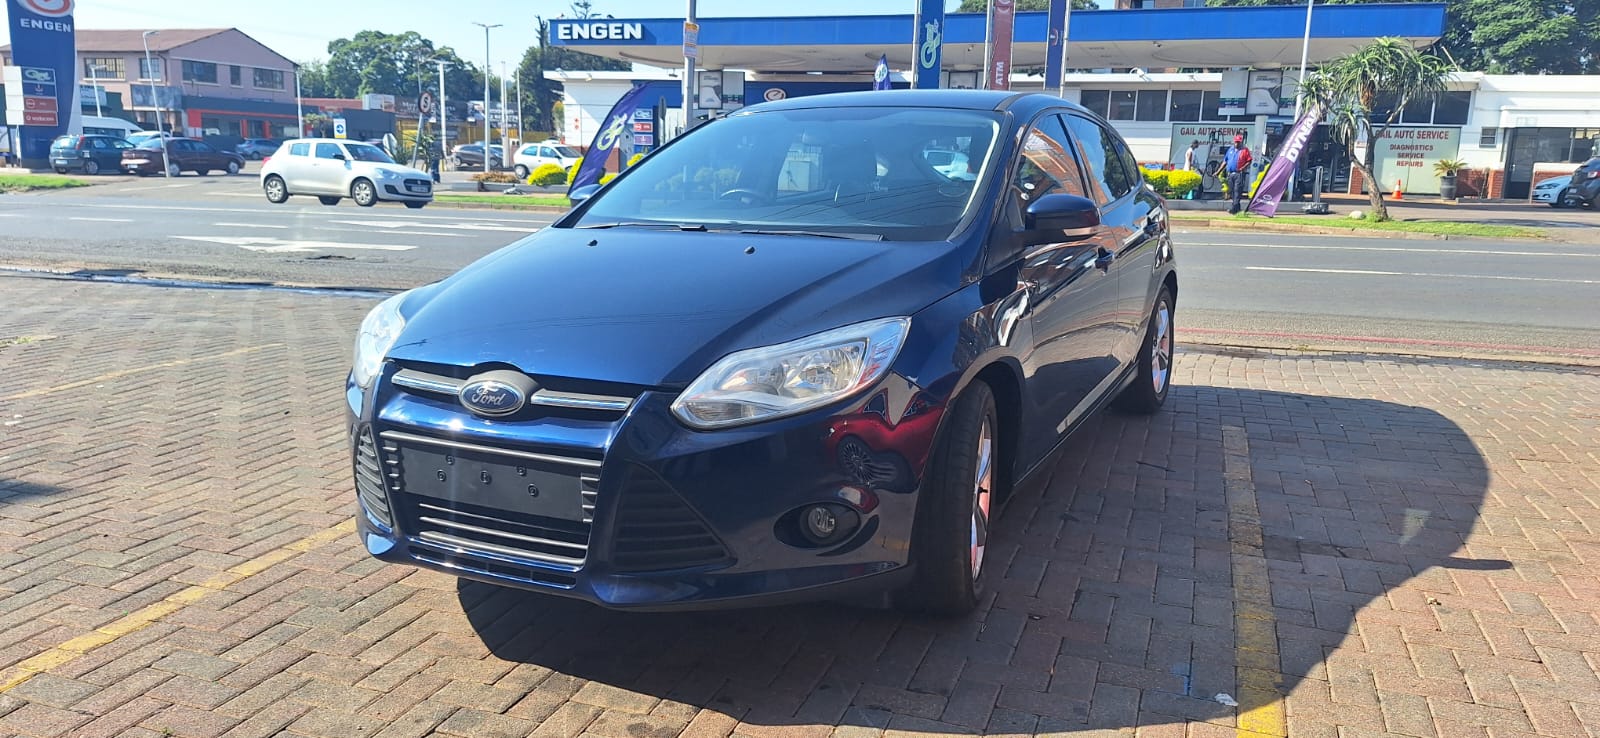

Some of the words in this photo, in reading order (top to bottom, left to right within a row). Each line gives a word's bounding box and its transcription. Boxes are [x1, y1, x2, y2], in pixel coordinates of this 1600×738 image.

[20, 18, 71, 32] ENGEN
[557, 23, 642, 40] ENGEN
[995, 61, 1005, 86] ATM
[1180, 127, 1196, 136] GAIL
[1394, 130, 1415, 139] AUTO
[1416, 130, 1449, 140] SERVICE
[471, 384, 506, 405] Ford
